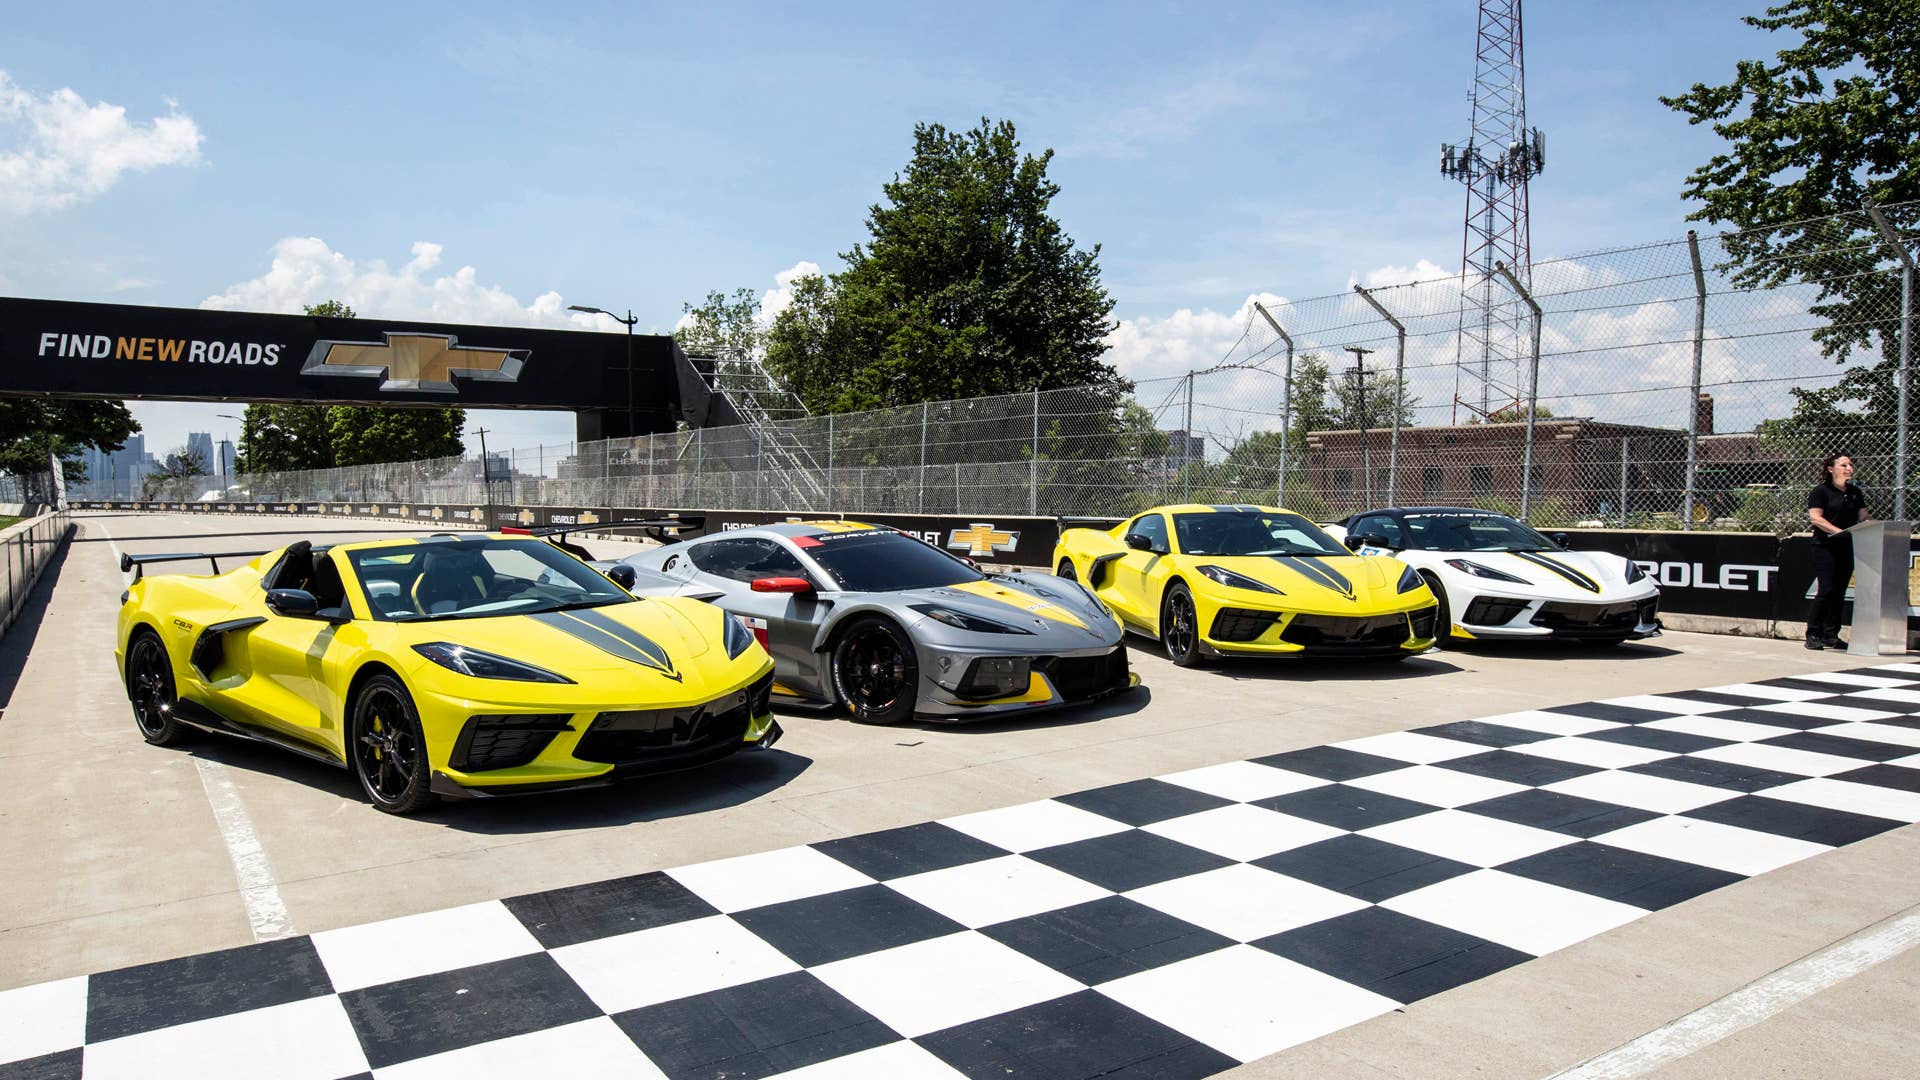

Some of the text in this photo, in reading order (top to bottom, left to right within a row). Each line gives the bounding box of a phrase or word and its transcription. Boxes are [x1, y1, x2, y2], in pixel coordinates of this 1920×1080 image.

[38, 332, 111, 359] FIND
[115, 336, 186, 362] NEW
[551, 515, 576, 525] CHEVROLET
